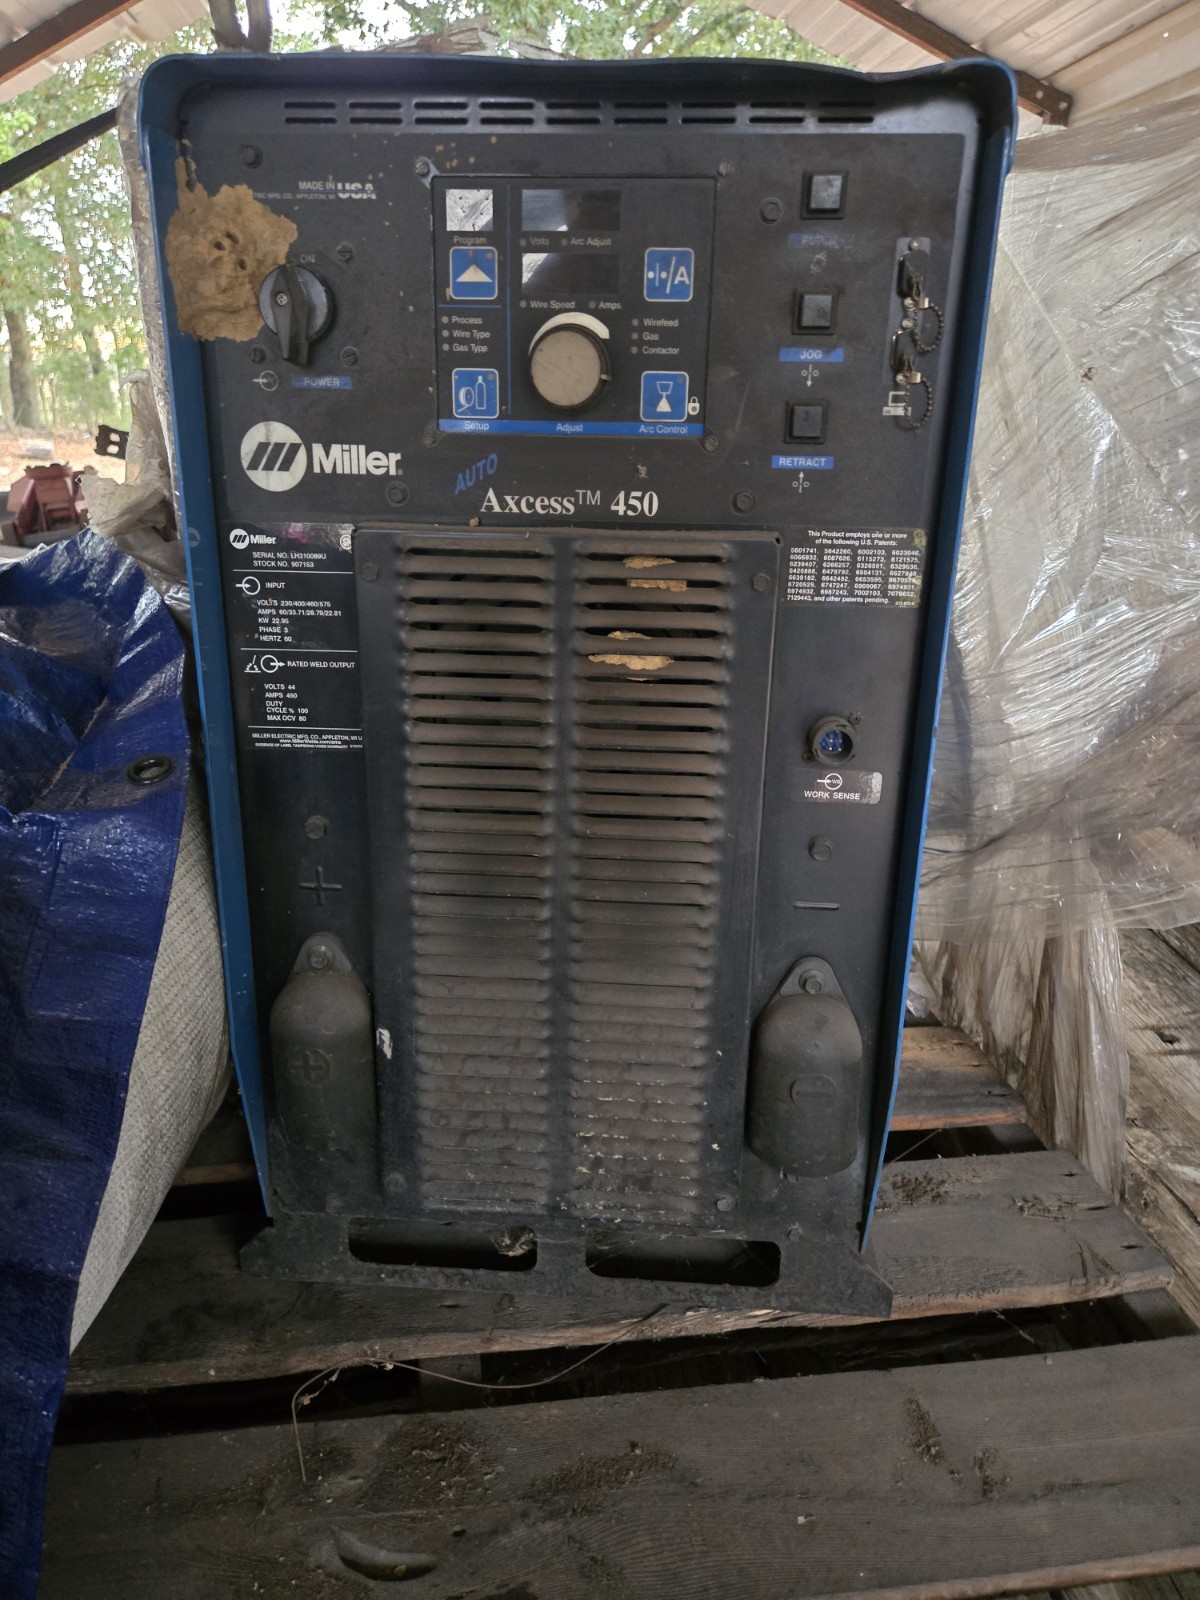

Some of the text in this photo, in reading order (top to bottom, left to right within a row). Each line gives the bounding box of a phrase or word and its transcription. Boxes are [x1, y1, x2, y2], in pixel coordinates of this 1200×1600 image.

[298, 181, 335, 190] MADE IN
[337, 182, 377, 200] USA
[453, 236, 487, 245] Program
[530, 237, 549, 245] Volts
[570, 238, 612, 247] Arc Adjust
[300, 254, 315, 263] ON
[549, 301, 576, 311] Speed
[598, 301, 622, 311] Amps
[451, 316, 483, 325] Process
[643, 319, 679, 327] Wirefeed
[453, 330, 491, 339] Wire Type
[642, 331, 660, 340] Gas
[453, 344, 488, 353] Gas Type
[642, 346, 680, 355] Contactor
[800, 350, 822, 360] JOG
[303, 377, 340, 387] POWER
[464, 421, 490, 431] Setup
[556, 423, 584, 433] Adjust
[638, 424, 688, 434] Arc Control
[311, 442, 402, 476] Miller
[779, 458, 827, 467] RETRACT
[455, 453, 497, 495] AUTO
[610, 490, 659, 517] 450
[250, 535, 277, 545] Miller
[804, 790, 860, 800] WORK SENSE
